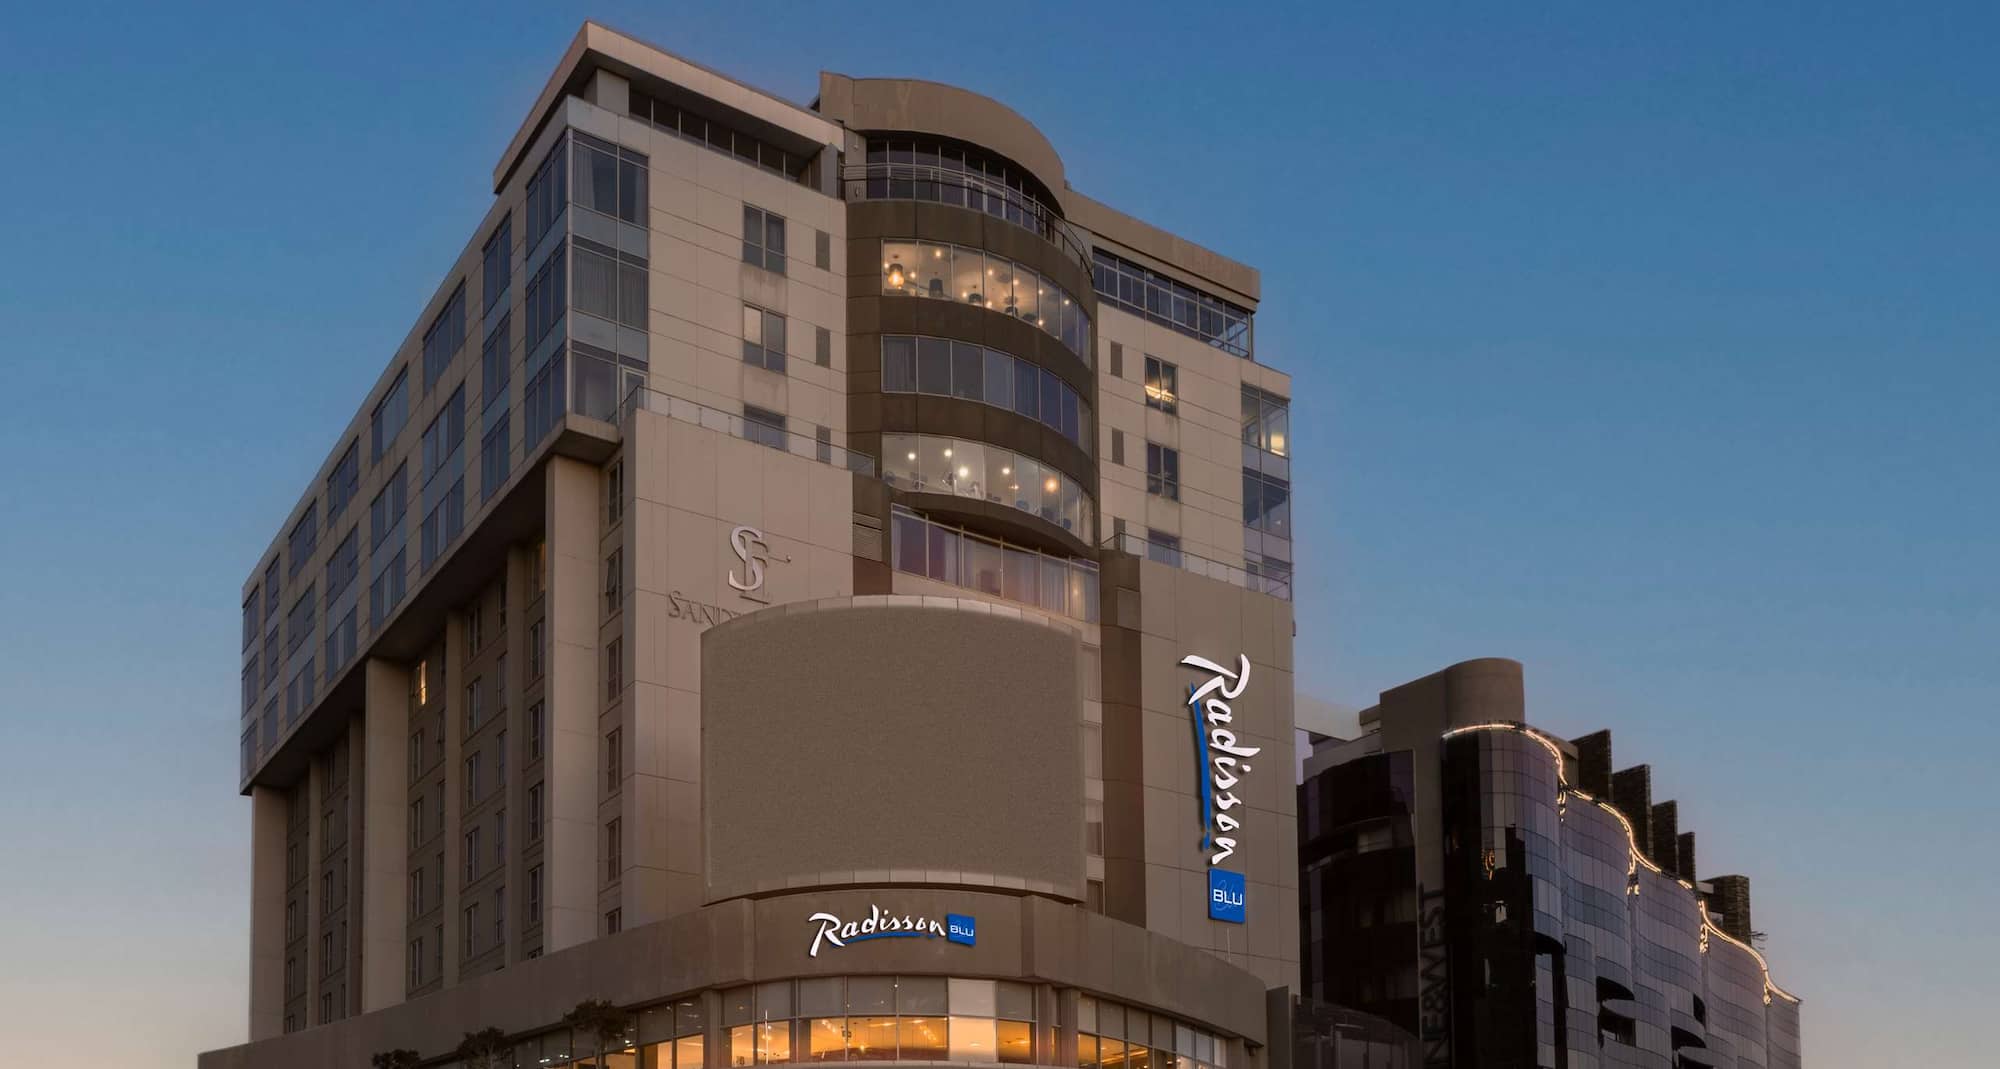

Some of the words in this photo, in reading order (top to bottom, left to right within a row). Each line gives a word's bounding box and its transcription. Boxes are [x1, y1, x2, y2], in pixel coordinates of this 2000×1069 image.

[668, 591, 741, 624] SAND
[1181, 653, 1261, 865] Radisson
[1213, 888, 1243, 906] BLU
[809, 904, 946, 957] Radisson
[950, 925, 974, 937] BLU
